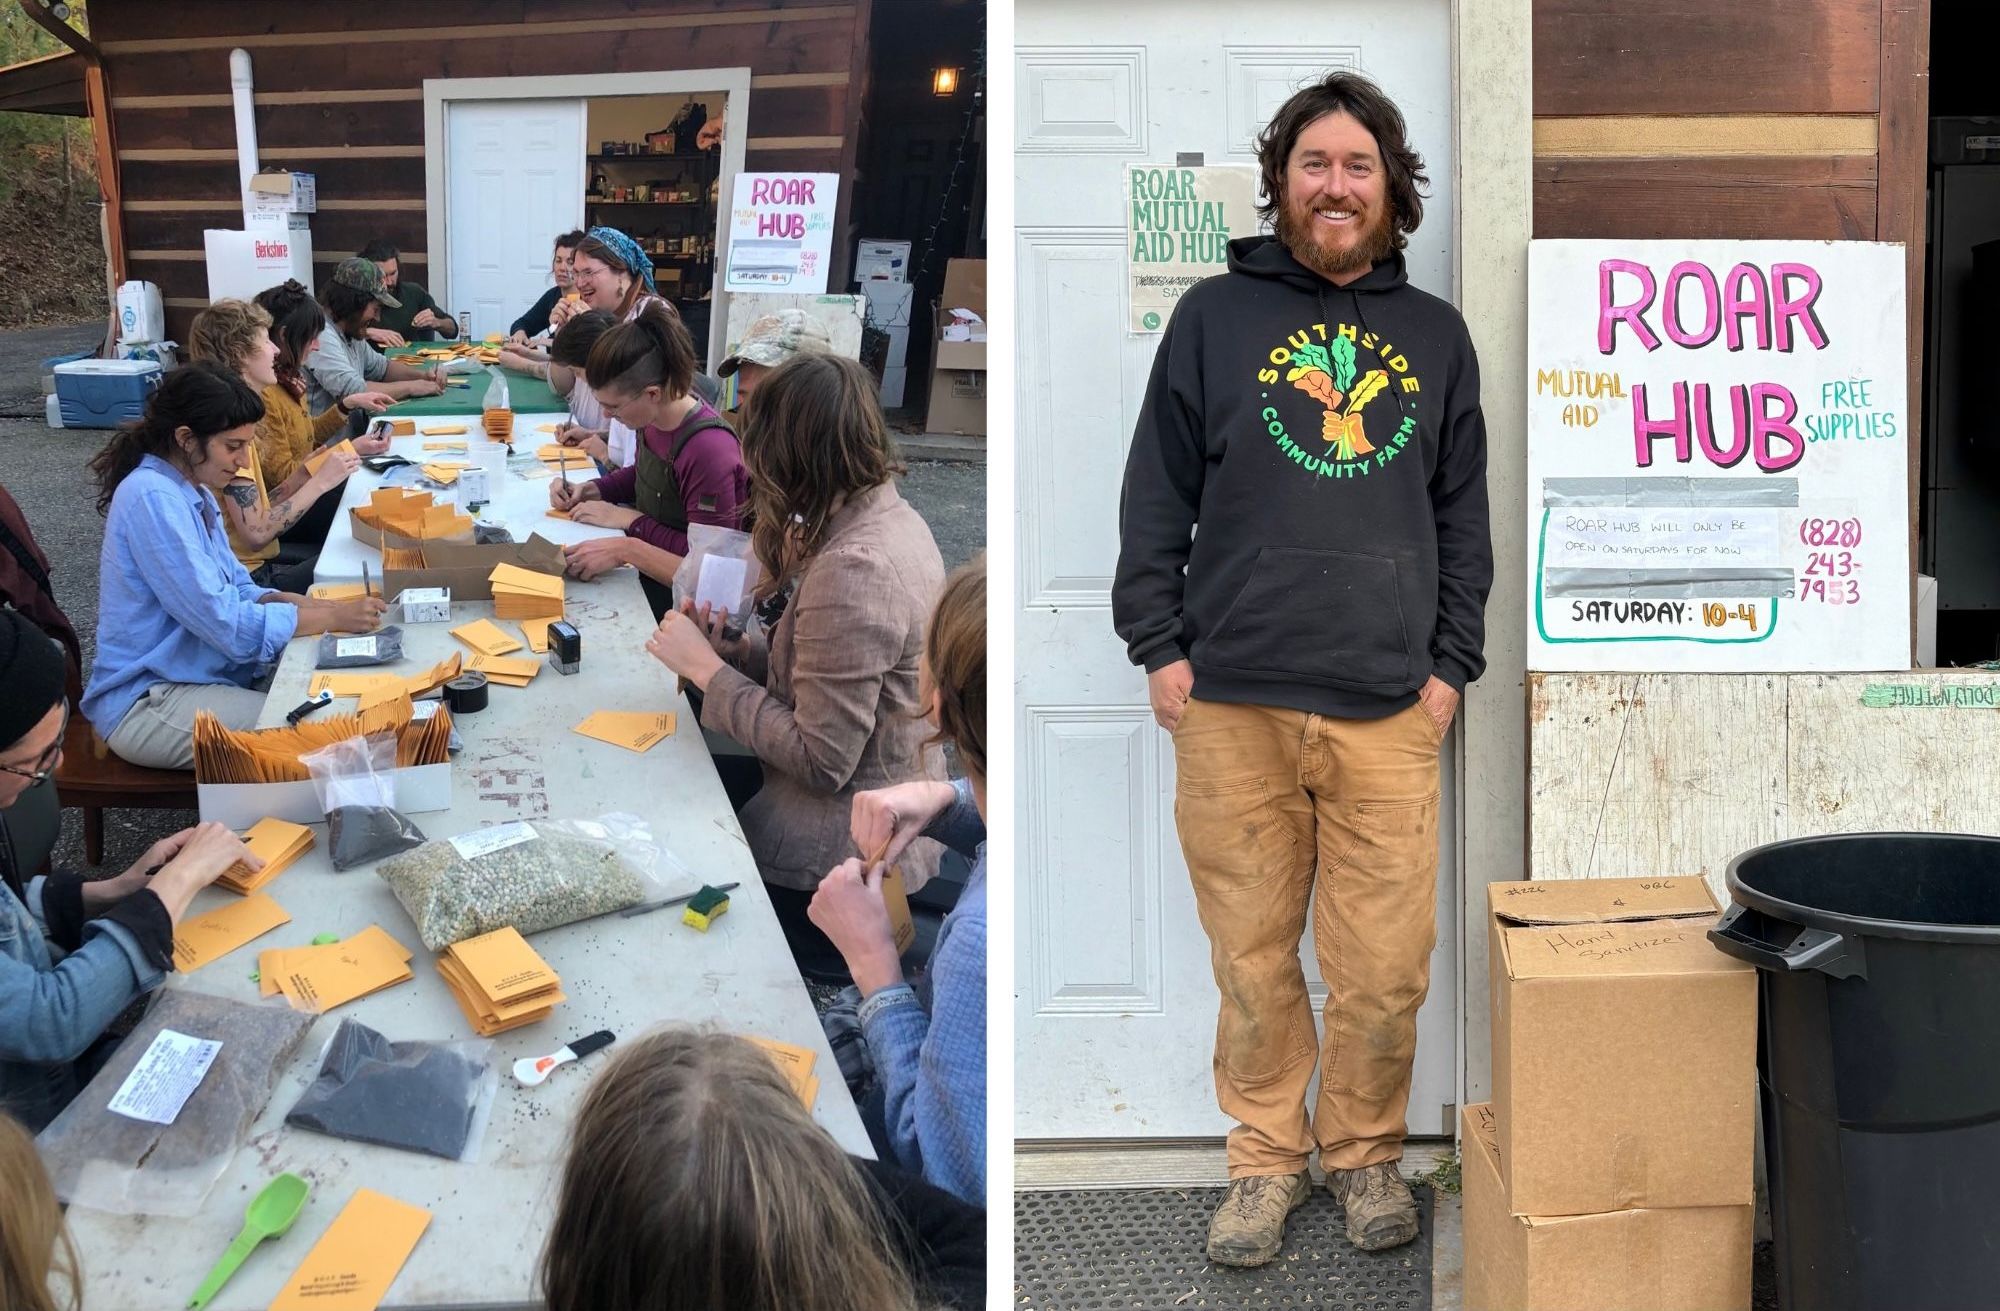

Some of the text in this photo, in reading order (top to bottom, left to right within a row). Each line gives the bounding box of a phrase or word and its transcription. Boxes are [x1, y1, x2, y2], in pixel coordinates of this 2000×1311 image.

[751, 178, 816, 206] ROAR
[1131, 169, 1197, 201] ROAR
[758, 213, 805, 239] HUB
[1132, 201, 1230, 232] MUTUAL
[255, 240, 288, 258] Berkshire
[1133, 231, 1230, 264] AID HUB
[1597, 258, 1830, 354] ROAR
[1257, 323, 1420, 393] SOUTHSIDE
[1537, 368, 1628, 399] MUTUAL
[1822, 379, 1873, 408] FREE
[1562, 404, 1598, 428] AID
[1631, 381, 1805, 474] HUB
[1805, 412, 1897, 443] SUPPLIES
[1262, 406, 1417, 478] COMMUNITY FARM
[1566, 515, 1746, 533] ROAR HUB WILL ONLY BE
[1800, 517, 1862, 548] (828)
[1565, 541, 1742, 555] OPEN ON SATURDAYS FOR NOW
[1806, 551, 1863, 577] 243-
[1800, 578, 1861, 606] 7953
[1571, 599, 1757, 632] SATURDAY: 10-4
[1955, 687, 1994, 706] DOLLY
[1545, 931, 1615, 954] Hand
[1578, 933, 1688, 960] Sanitizer
